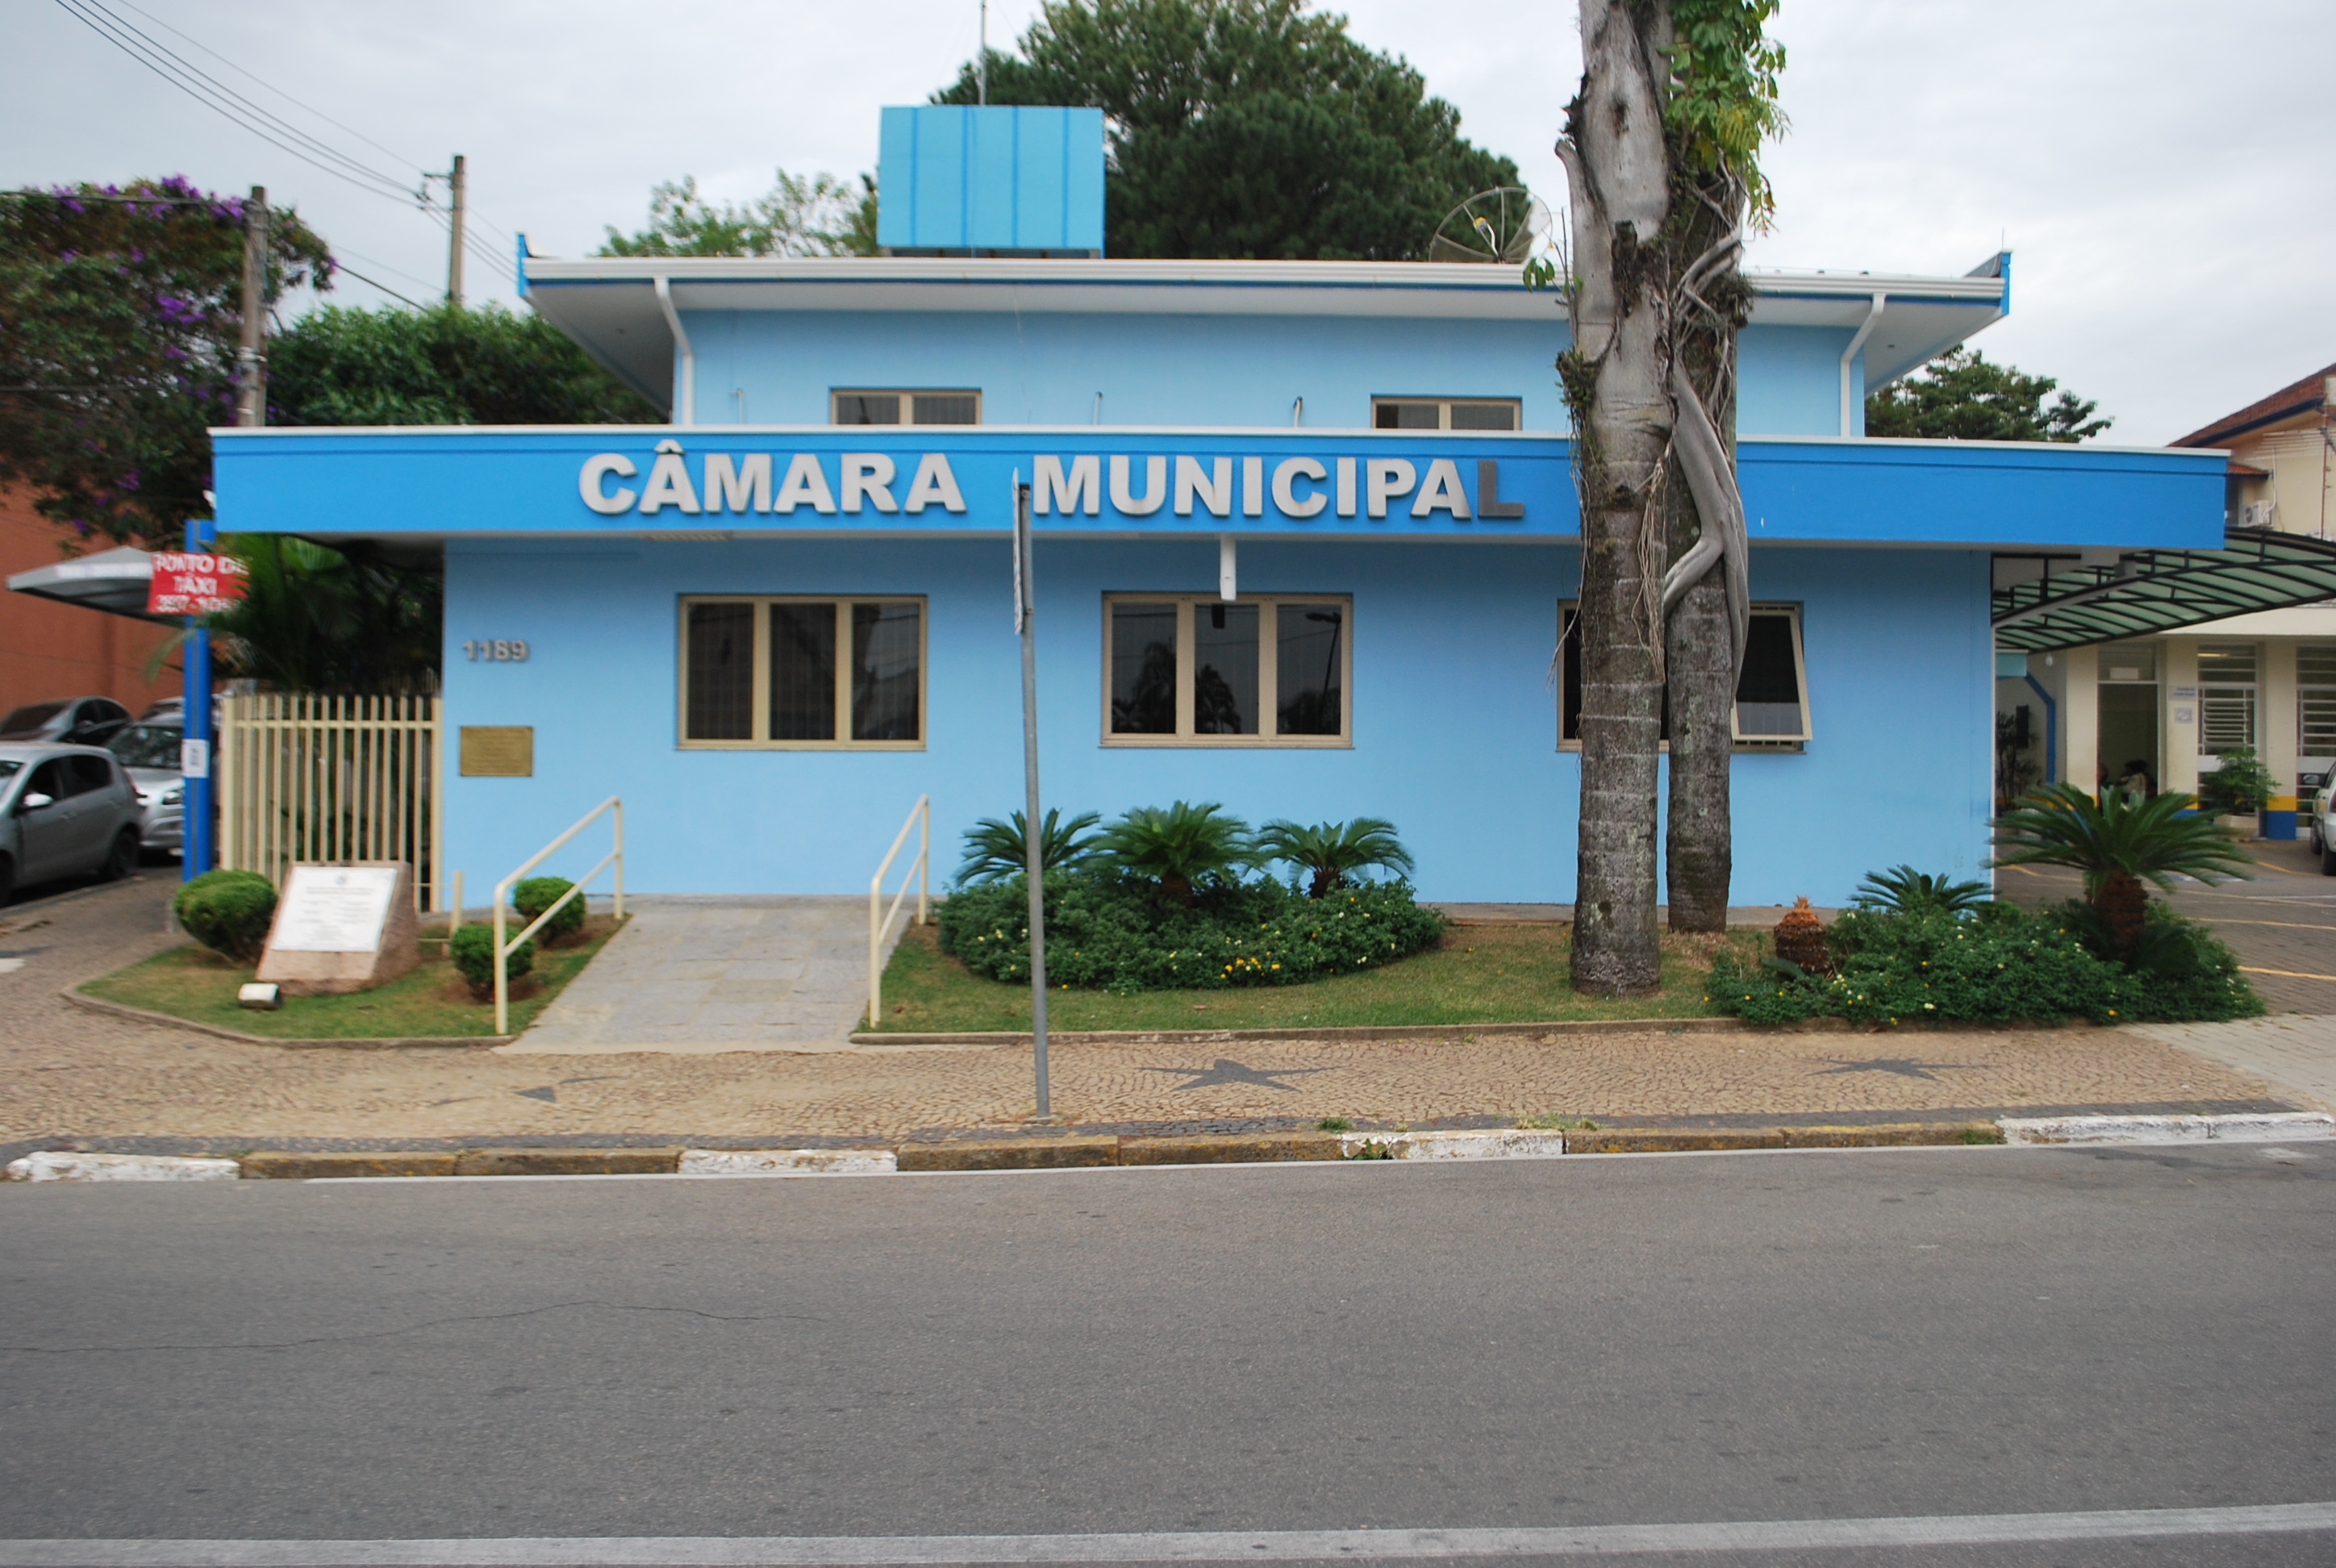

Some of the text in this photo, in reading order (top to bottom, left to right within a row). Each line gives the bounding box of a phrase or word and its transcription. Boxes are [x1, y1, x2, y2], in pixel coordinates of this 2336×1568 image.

[578, 439, 1525, 520] CÂMARA MUNICIPAL
[152, 553, 215, 573] PONTO
[172, 571, 218, 595] TÁXI
[463, 639, 529, 661] 1189
